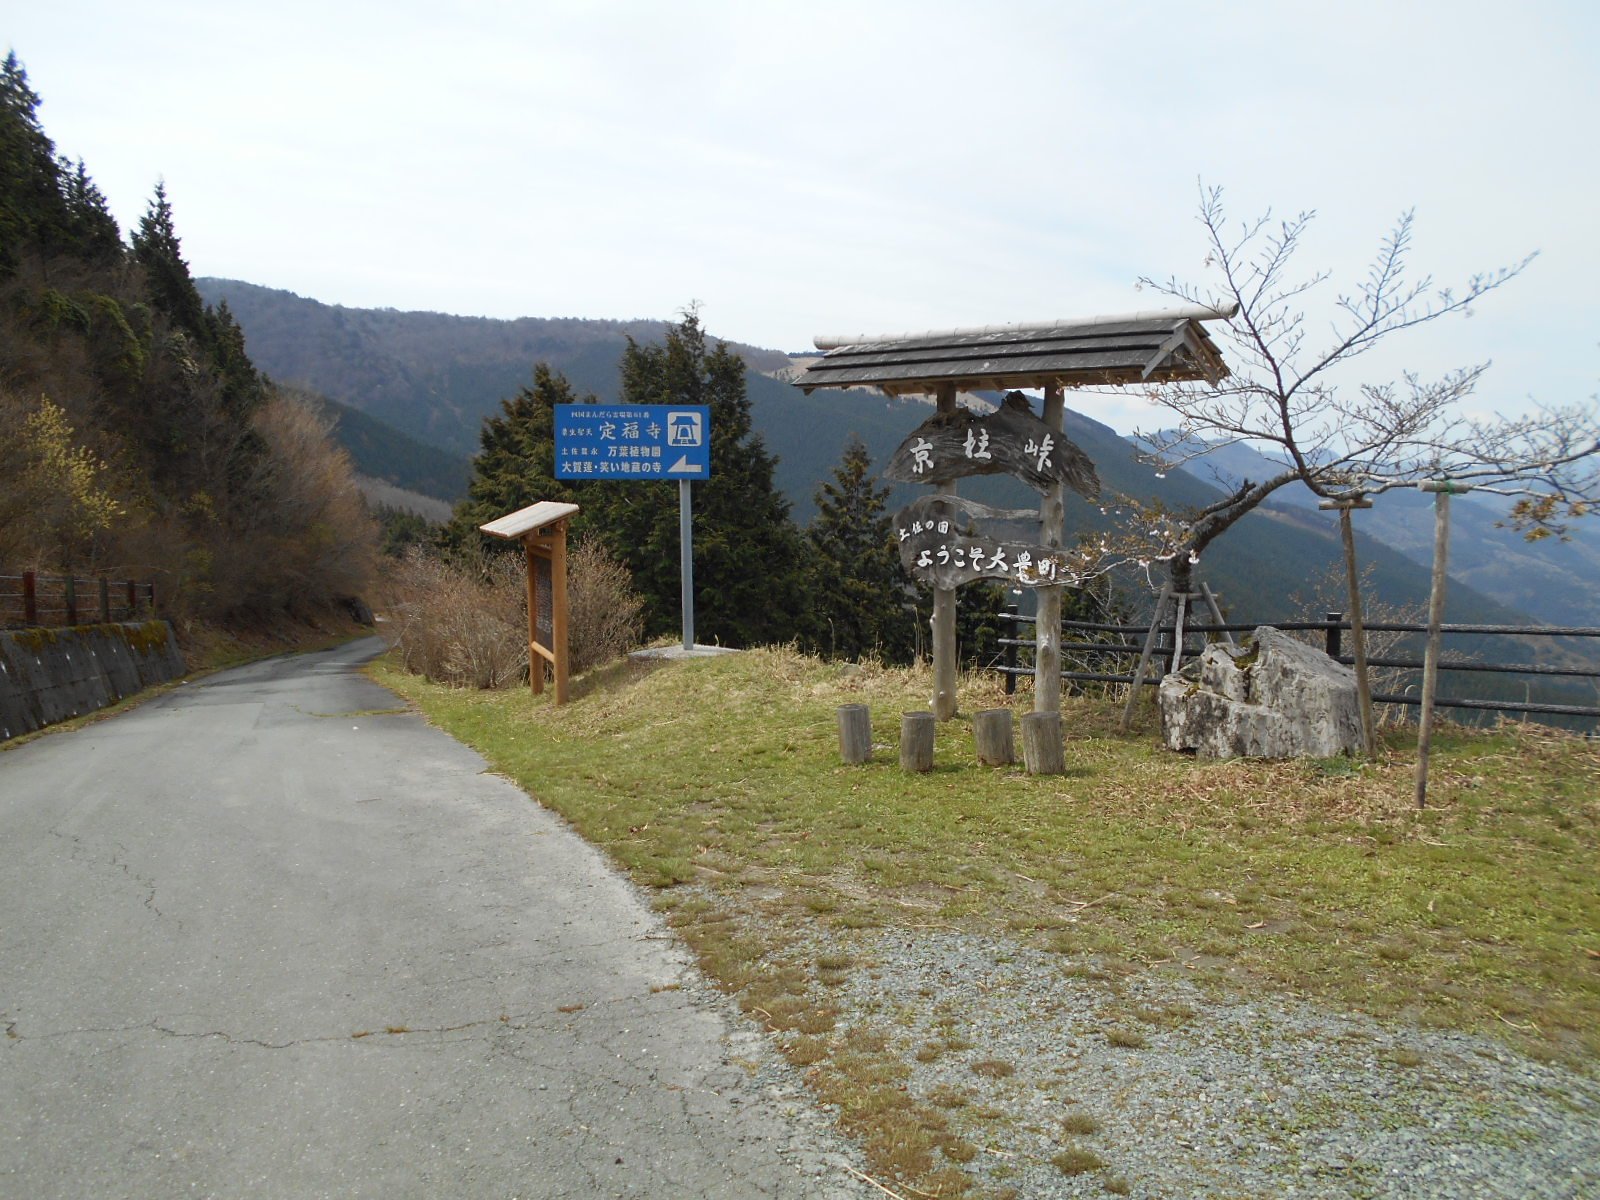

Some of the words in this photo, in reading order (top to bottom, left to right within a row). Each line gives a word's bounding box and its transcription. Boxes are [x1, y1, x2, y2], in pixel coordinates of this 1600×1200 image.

[600, 421, 662, 441] 定福寺
[607, 445, 661, 457] 万葉植物園
[910, 428, 1055, 474] 京柱峠
[899, 520, 949, 542] 土佐の国
